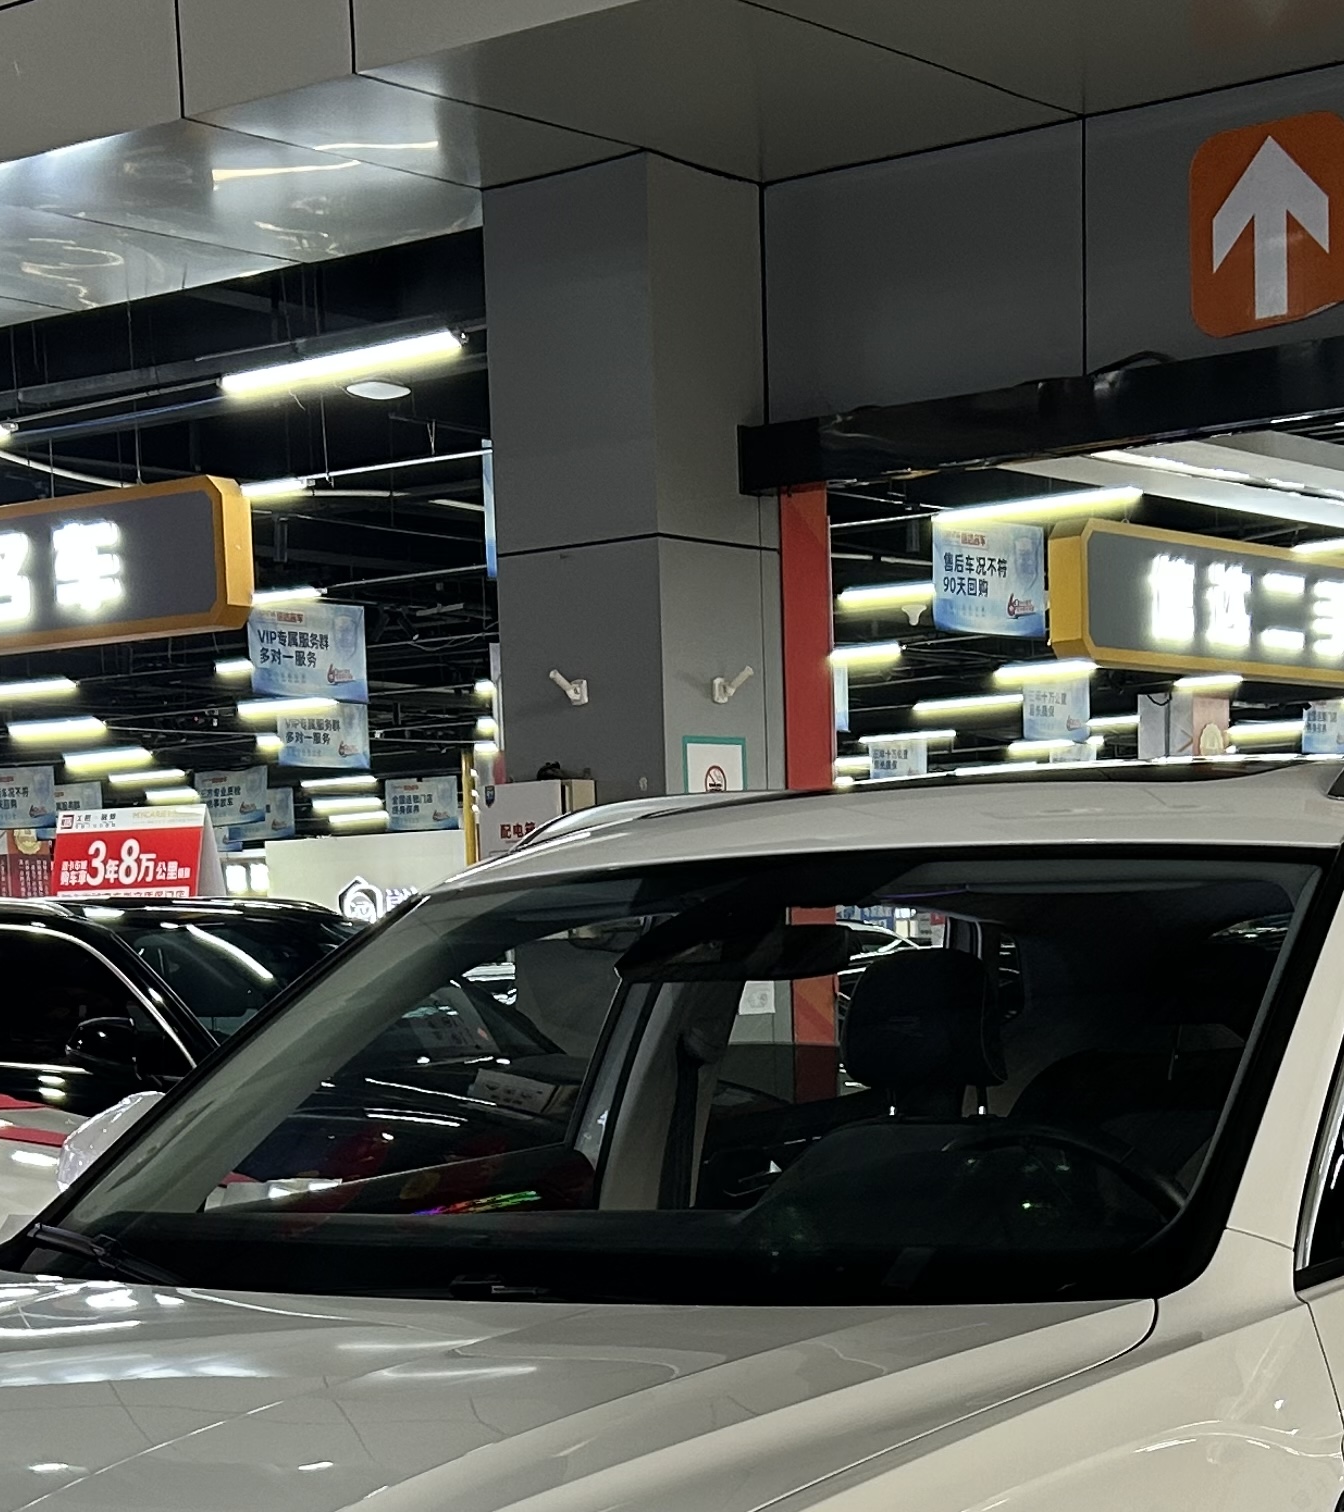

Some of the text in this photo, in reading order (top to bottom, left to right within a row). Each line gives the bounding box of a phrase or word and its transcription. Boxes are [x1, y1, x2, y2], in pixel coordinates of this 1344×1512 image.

[943, 552, 1008, 578] 售后车况不符
[943, 577, 988, 597] 90天回购
[257, 630, 329, 650] VIP专属服务群
[260, 648, 317, 668] 多对一服务
[285, 731, 331, 745] 多对一服务
